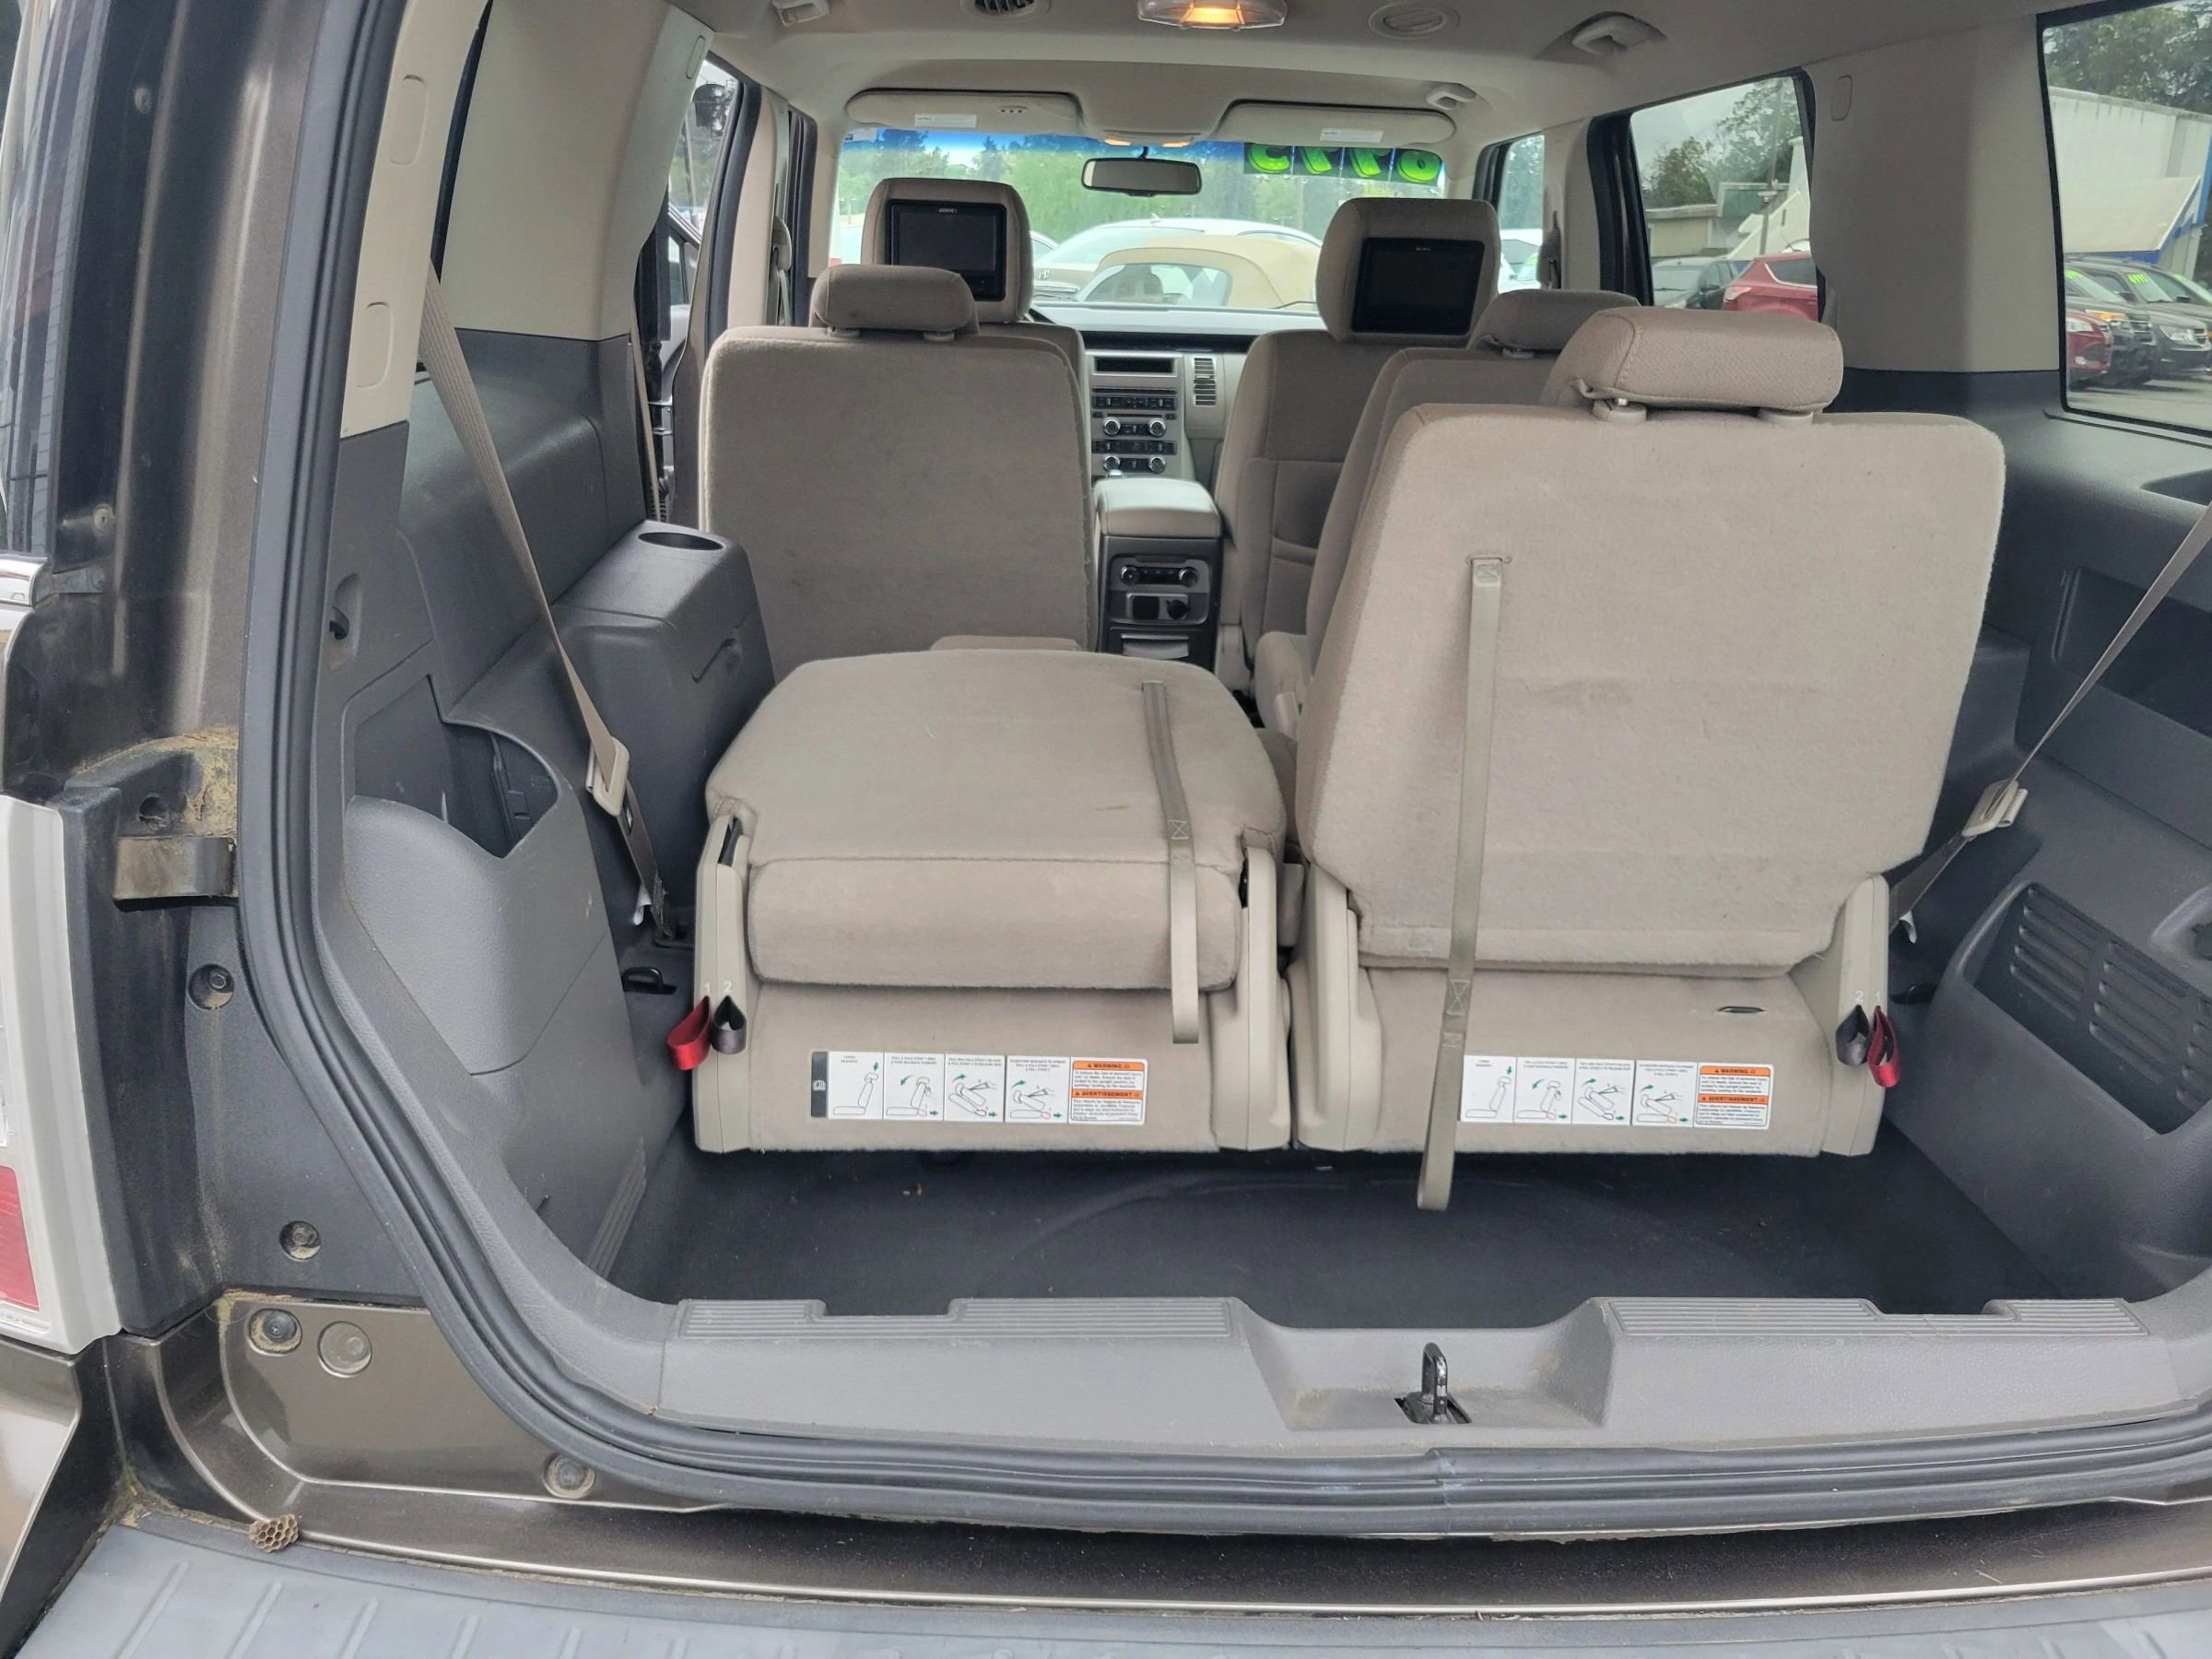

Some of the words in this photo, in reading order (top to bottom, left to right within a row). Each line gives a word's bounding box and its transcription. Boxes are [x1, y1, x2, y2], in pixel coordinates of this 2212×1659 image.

[704, 982, 711, 994] 1
[723, 981, 733, 994] 2
[1854, 990, 1865, 1002] 2
[1875, 991, 1881, 1002] 1
